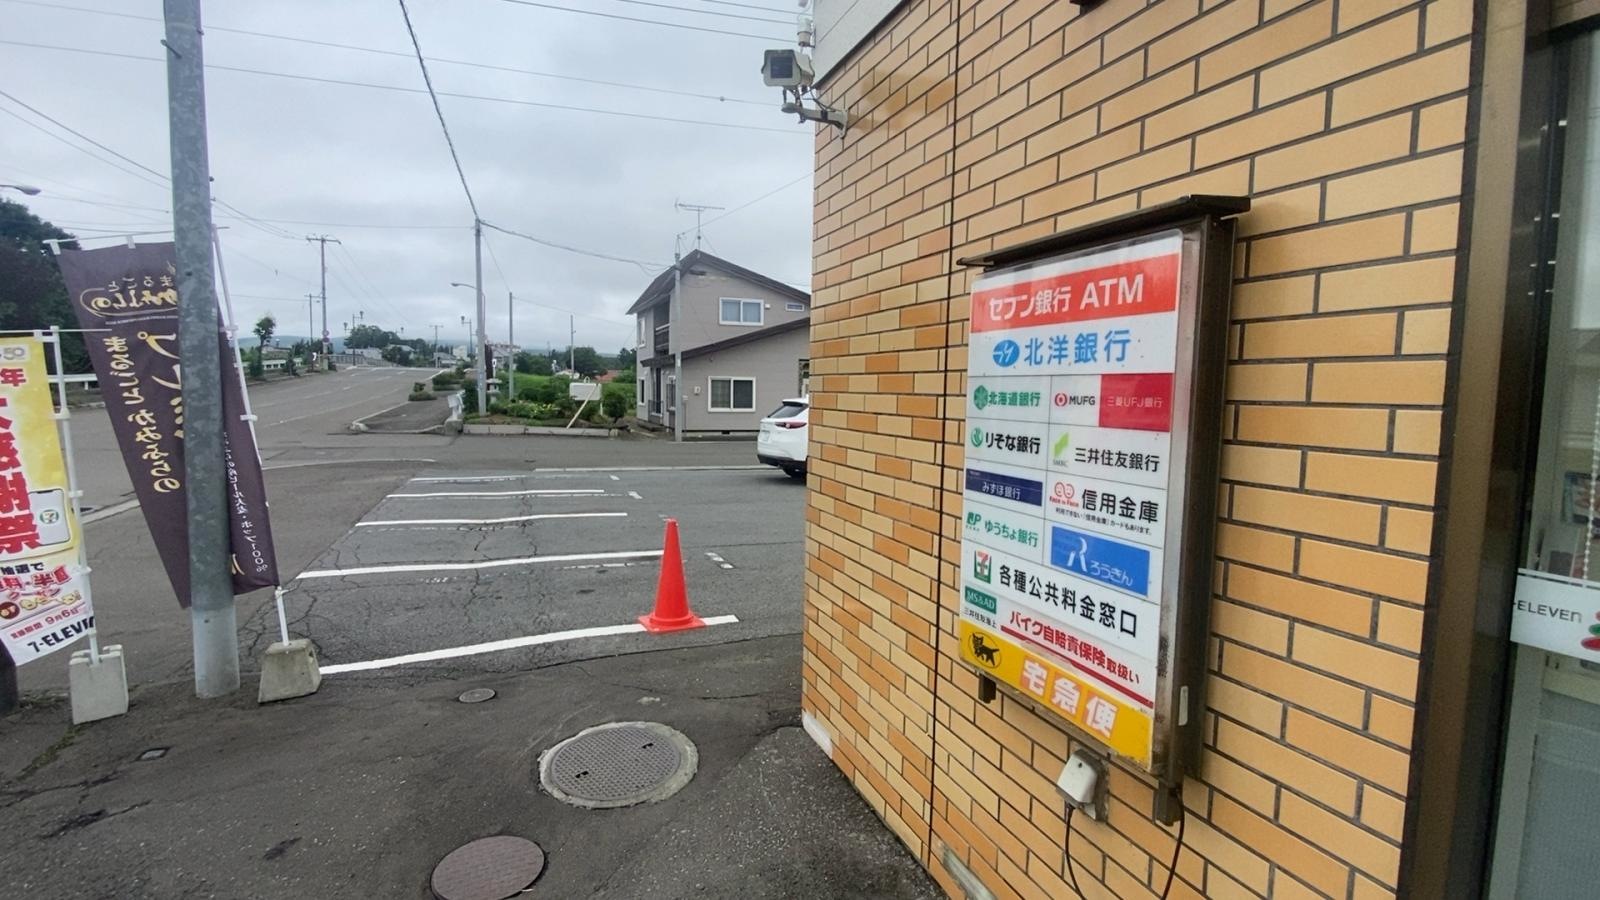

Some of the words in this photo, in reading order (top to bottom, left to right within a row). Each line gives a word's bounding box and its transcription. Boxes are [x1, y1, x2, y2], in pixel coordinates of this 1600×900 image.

[988, 286, 1072, 321] セブン銀行
[1079, 273, 1144, 311] ATM
[1023, 329, 1132, 367] 北洋銀行
[987, 390, 1041, 409] 北海道銀行
[1068, 395, 1096, 407] MUFG
[984, 431, 1041, 455] りそな銀行
[1075, 447, 1160, 473] 三井住友銀行
[981, 481, 1022, 502] みずほ銀行
[1081, 488, 1160, 524] 信用金庫
[984, 520, 1039, 548] ゆうちょ銀行
[1090, 560, 1134, 586] ろうきん
[966, 590, 995, 609] MS&AD
[998, 563, 1138, 638] 各種公共料金窓口
[1021, 658, 1119, 738] 宅急便
